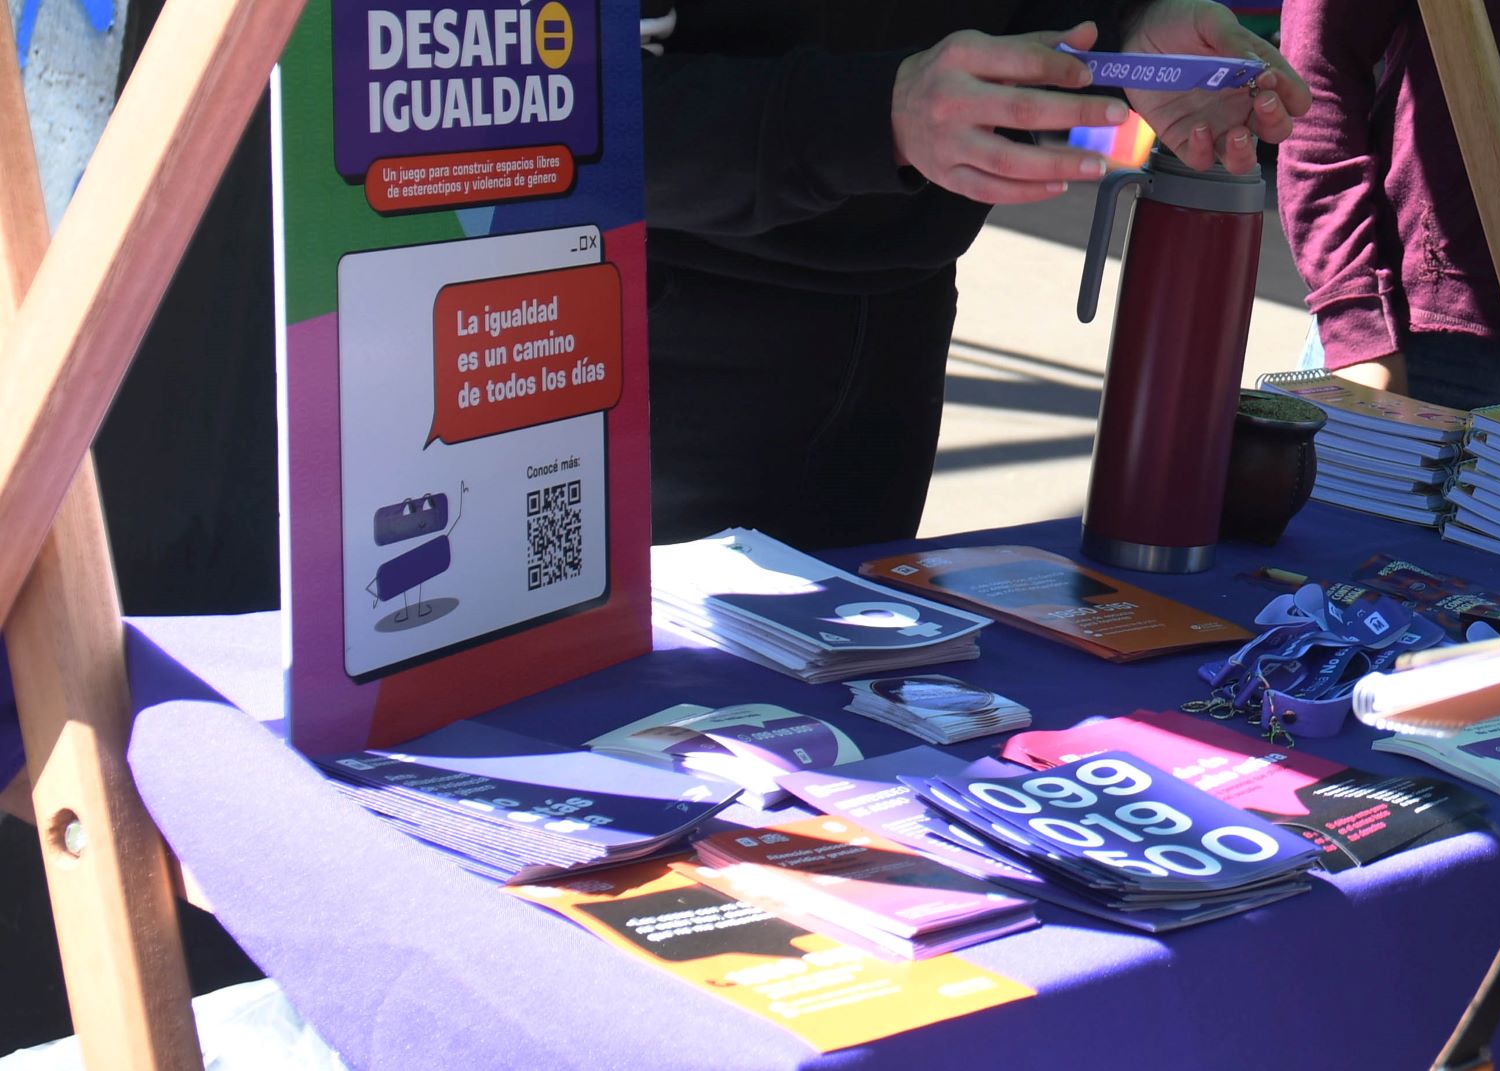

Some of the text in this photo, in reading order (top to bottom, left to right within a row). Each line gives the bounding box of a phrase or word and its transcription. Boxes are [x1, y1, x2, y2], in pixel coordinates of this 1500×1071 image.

[1100, 62, 1182, 83] 099 019 500
[368, 74, 574, 134] IGUALDAD
[382, 155, 561, 184] Un juego para construir espacios libres
[387, 171, 557, 199] de estereotipos y violencia de género
[457, 295, 558, 337] La igualdad
[457, 329, 575, 373] es un camino
[458, 356, 606, 409] de todos los días
[526, 454, 581, 479] Conocé más:
[1319, 658, 1341, 675] No
[968, 759, 1152, 814] 099
[1028, 801, 1193, 848] 019
[1083, 826, 1280, 877] 500
